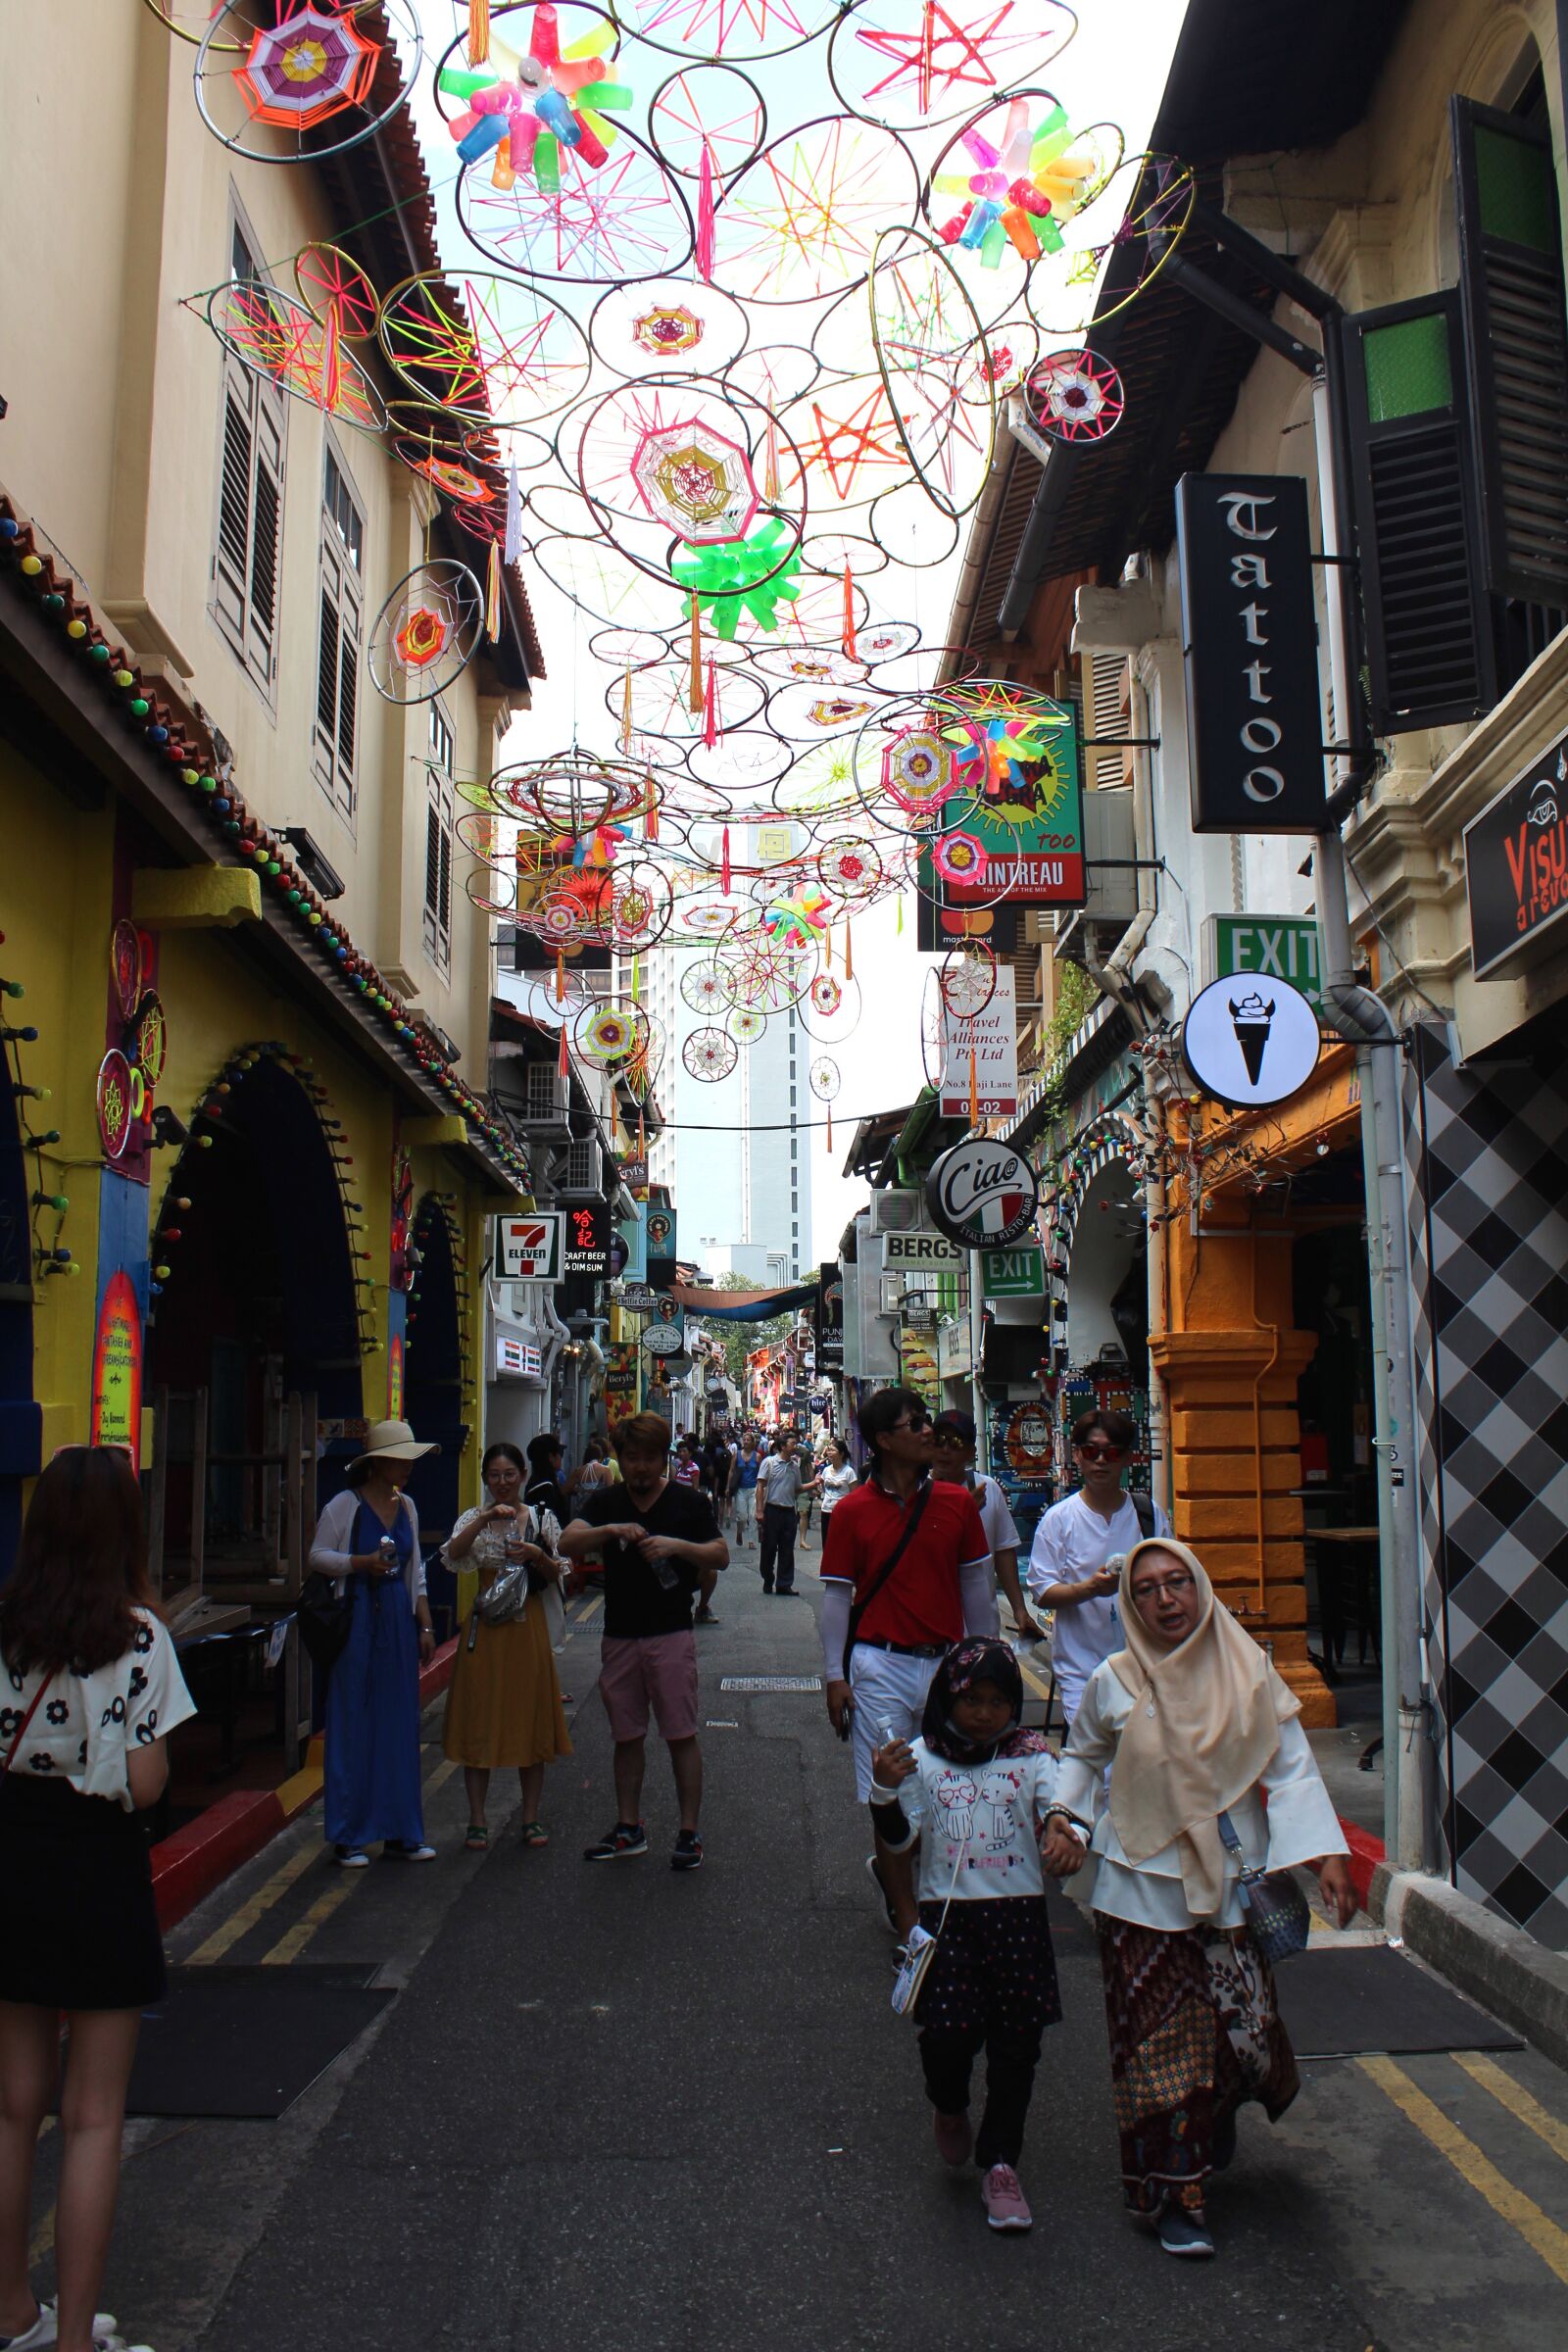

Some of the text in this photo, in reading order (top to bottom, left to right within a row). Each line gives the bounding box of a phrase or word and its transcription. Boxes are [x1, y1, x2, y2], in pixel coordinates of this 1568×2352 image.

[1216, 491, 1286, 803] Tattoo
[1037, 832, 1076, 850] TOO
[1504, 814, 1568, 904] VISU
[968, 861, 1063, 885] INTREAU
[1232, 928, 1318, 978] EXIT
[958, 1016, 1001, 1028] Travel
[949, 1032, 1010, 1044] Alliances
[955, 1048, 1004, 1060] Pt Ltd
[946, 1080, 966, 1089] No.8
[990, 1080, 1012, 1089] Lane
[960, 1101, 1001, 1114] 0-02
[959, 1225, 996, 1244] ITALIAN
[888, 1237, 963, 1259] BERGS
[564, 1251, 607, 1260] CRAFT BEER
[571, 1263, 586, 1272] DIM
[586, 1263, 604, 1272] SUM
[989, 1251, 1033, 1279] EXIT
[609, 1373, 634, 1384] Beryl's
[946, 1843, 971, 1857] BET
